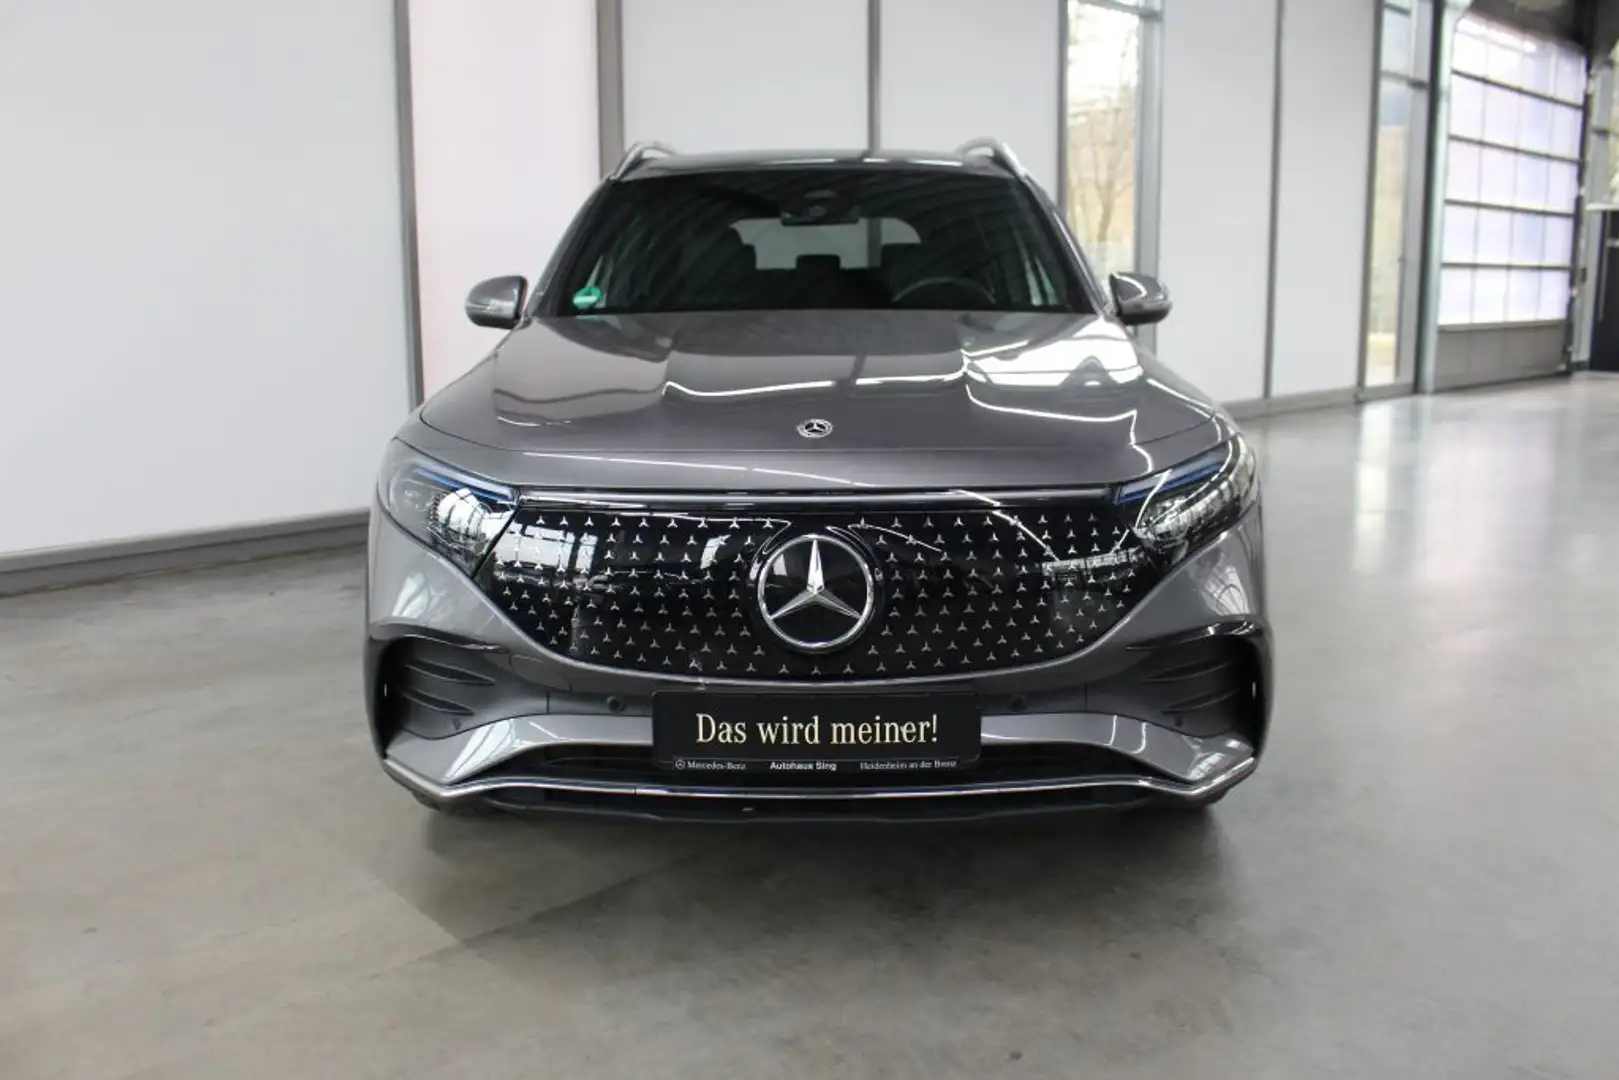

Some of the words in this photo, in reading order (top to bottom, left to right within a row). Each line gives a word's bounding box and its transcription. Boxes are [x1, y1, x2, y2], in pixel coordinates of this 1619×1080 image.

[696, 713, 747, 743] Das
[756, 715, 821, 744] wird
[830, 713, 938, 744] meiner!
[687, 760, 746, 770] Mercedes-Benz
[769, 761, 814, 770] Autohaus
[815, 761, 837, 772] Sing
[860, 760, 908, 771] Heidenheim
[920, 760, 933, 769] der
[934, 759, 957, 769] Brenz
